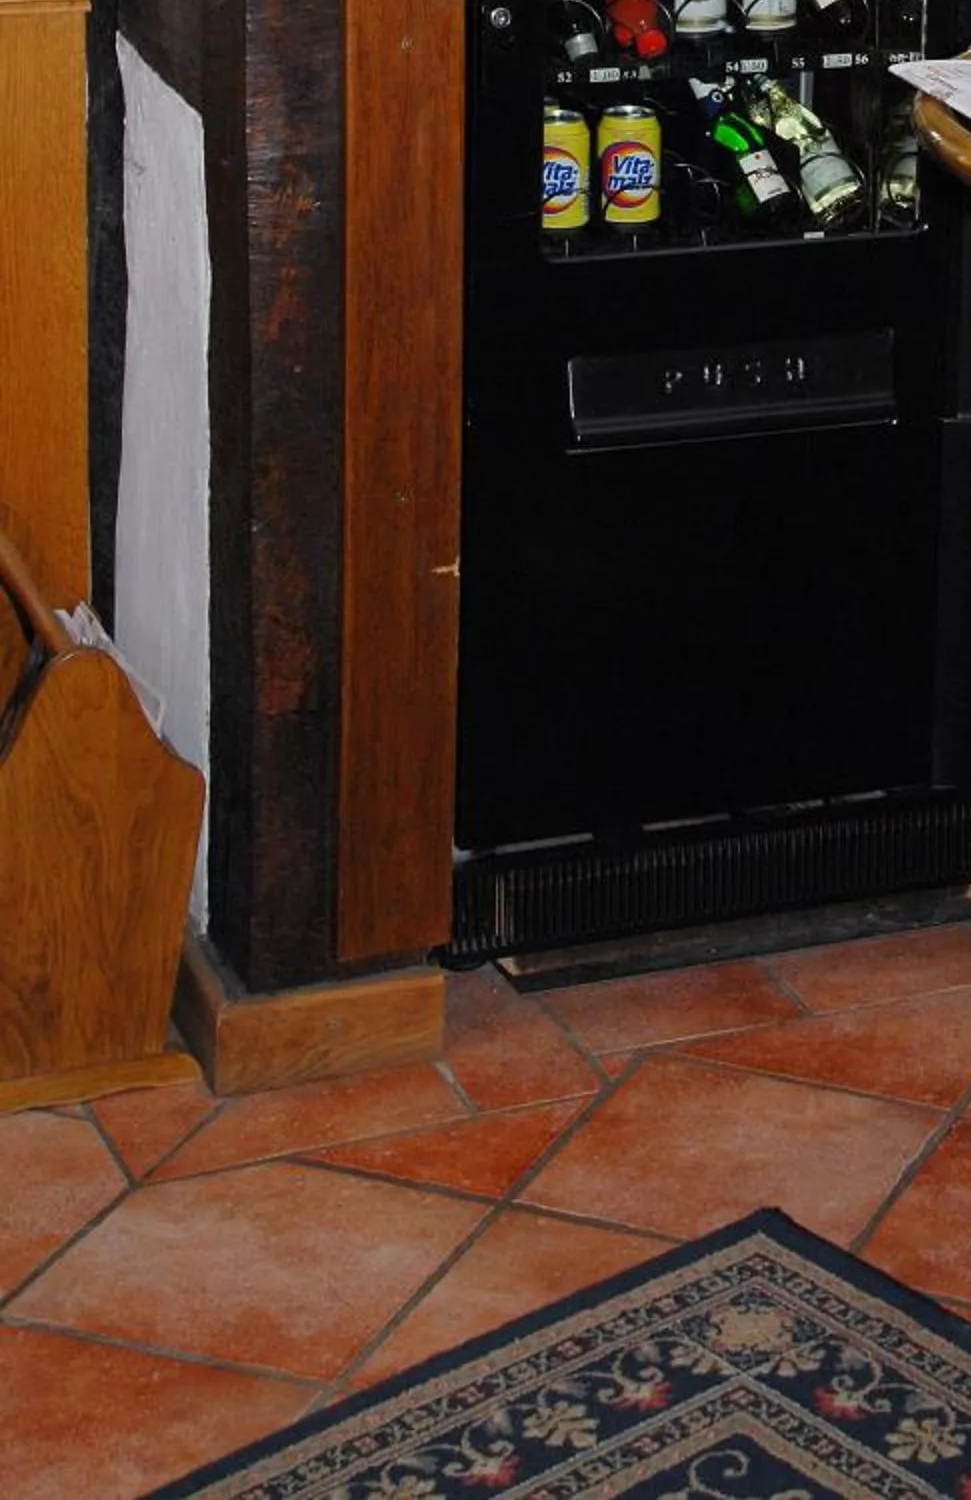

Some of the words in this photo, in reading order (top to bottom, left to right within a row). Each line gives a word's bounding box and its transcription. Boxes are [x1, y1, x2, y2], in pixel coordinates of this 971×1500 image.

[791, 58, 805, 69] 55
[854, 54, 869, 65] 56
[725, 61, 739, 73] 54
[557, 71, 573, 83] 52
[544, 180, 576, 197] alz
